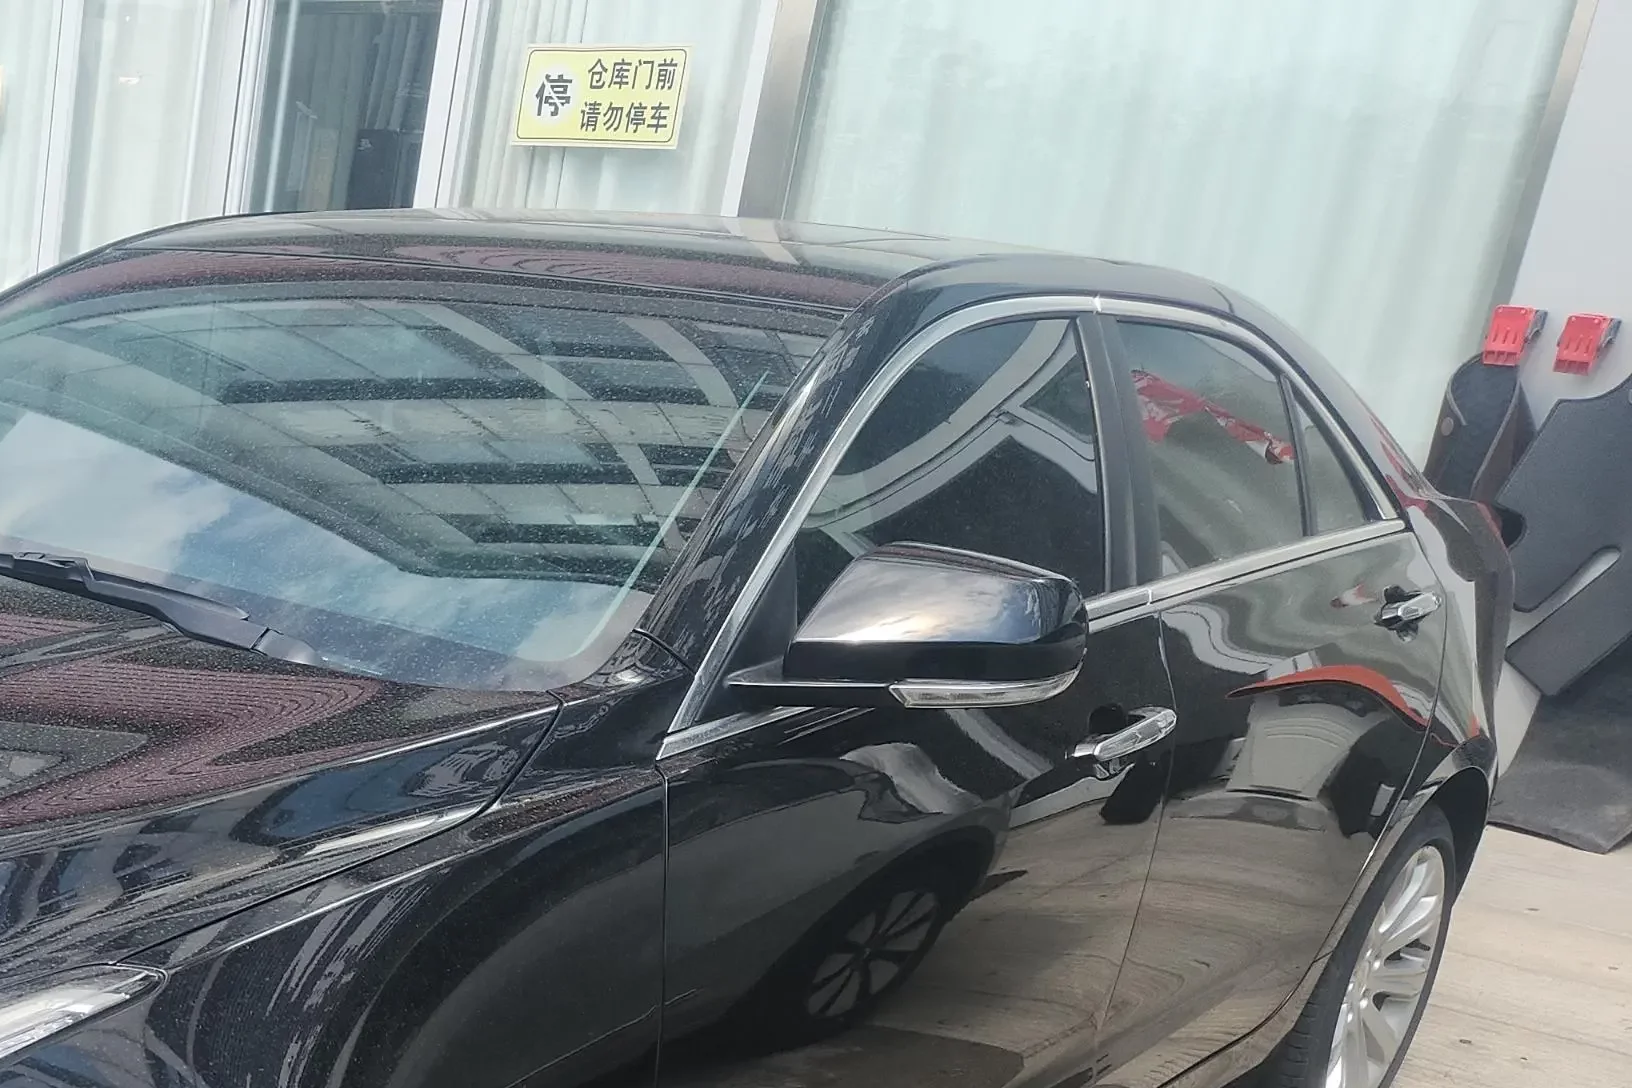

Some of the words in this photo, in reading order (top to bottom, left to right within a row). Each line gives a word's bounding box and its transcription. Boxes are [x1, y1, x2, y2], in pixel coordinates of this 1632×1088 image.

[588, 58, 678, 90] 仓库门前
[535, 74, 573, 117] 停
[580, 101, 670, 134] 请勿停车
